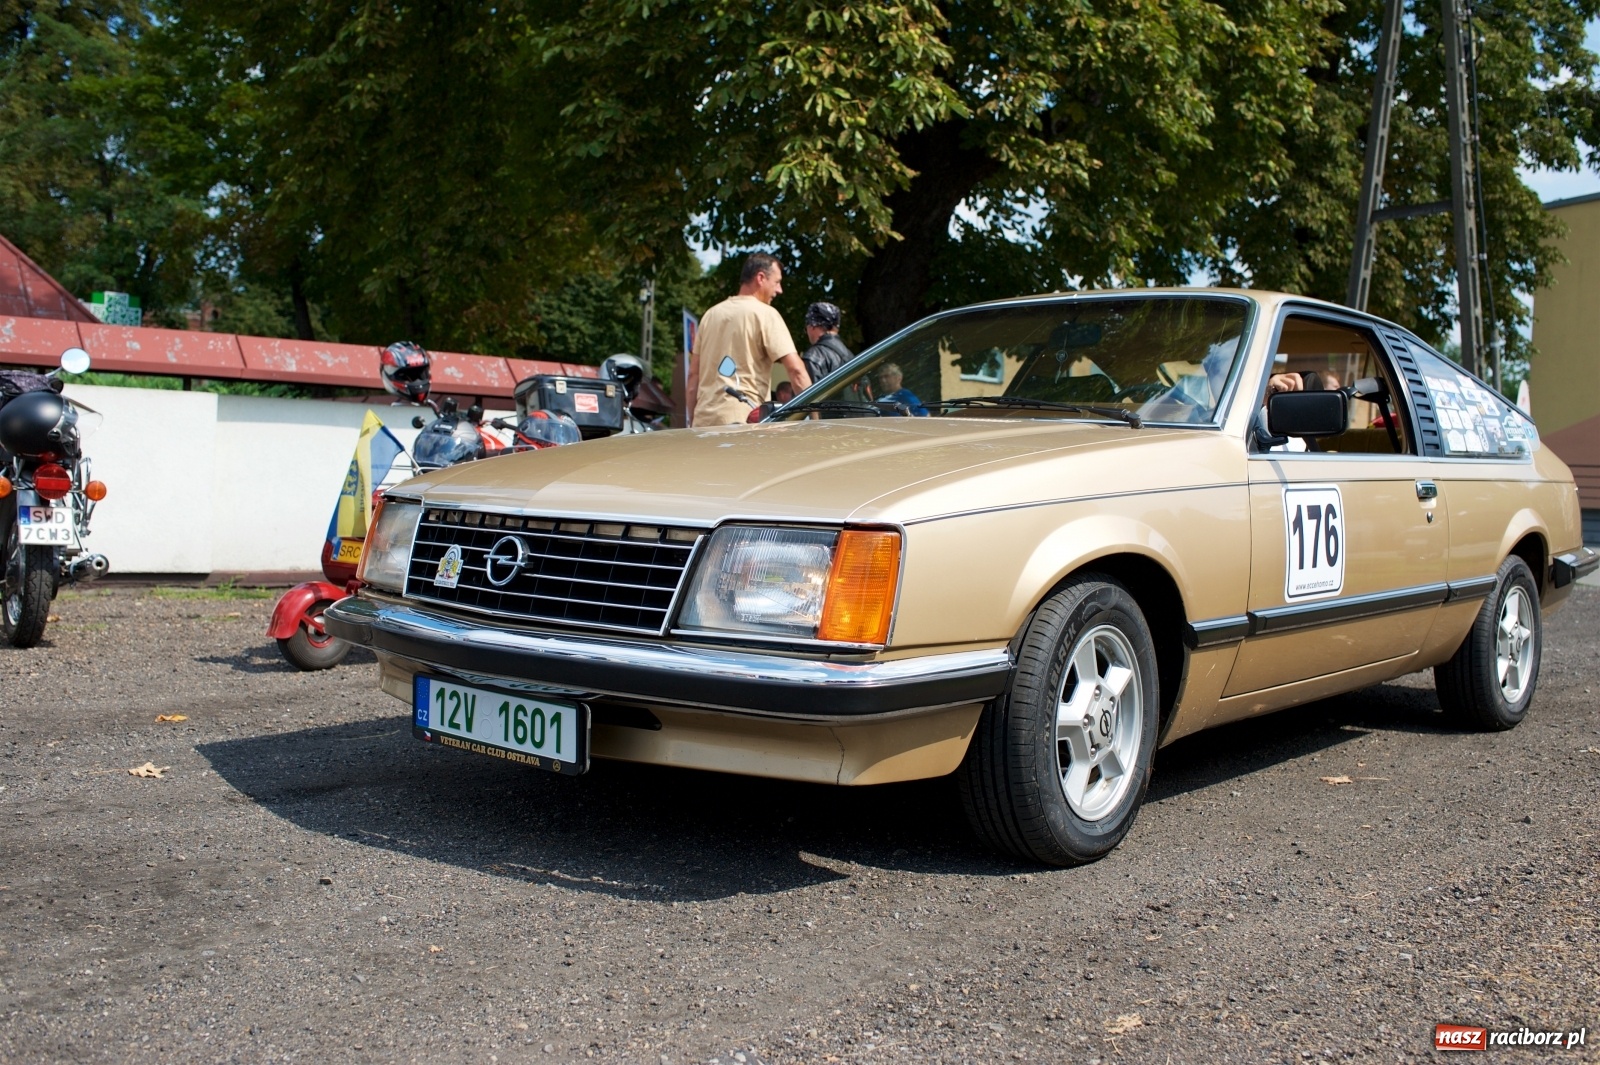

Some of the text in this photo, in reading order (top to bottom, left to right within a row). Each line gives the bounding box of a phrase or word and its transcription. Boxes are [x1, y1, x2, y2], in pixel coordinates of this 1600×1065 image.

[32, 510, 66, 524] SWD
[24, 527, 71, 541] 7CW3
[1292, 503, 1339, 570] 176
[339, 544, 361, 558] SRC
[417, 708, 428, 721] CZ
[435, 687, 562, 754] 12V 1601
[440, 735, 541, 767] VETERAN CAR CLUB OSTRAVA
